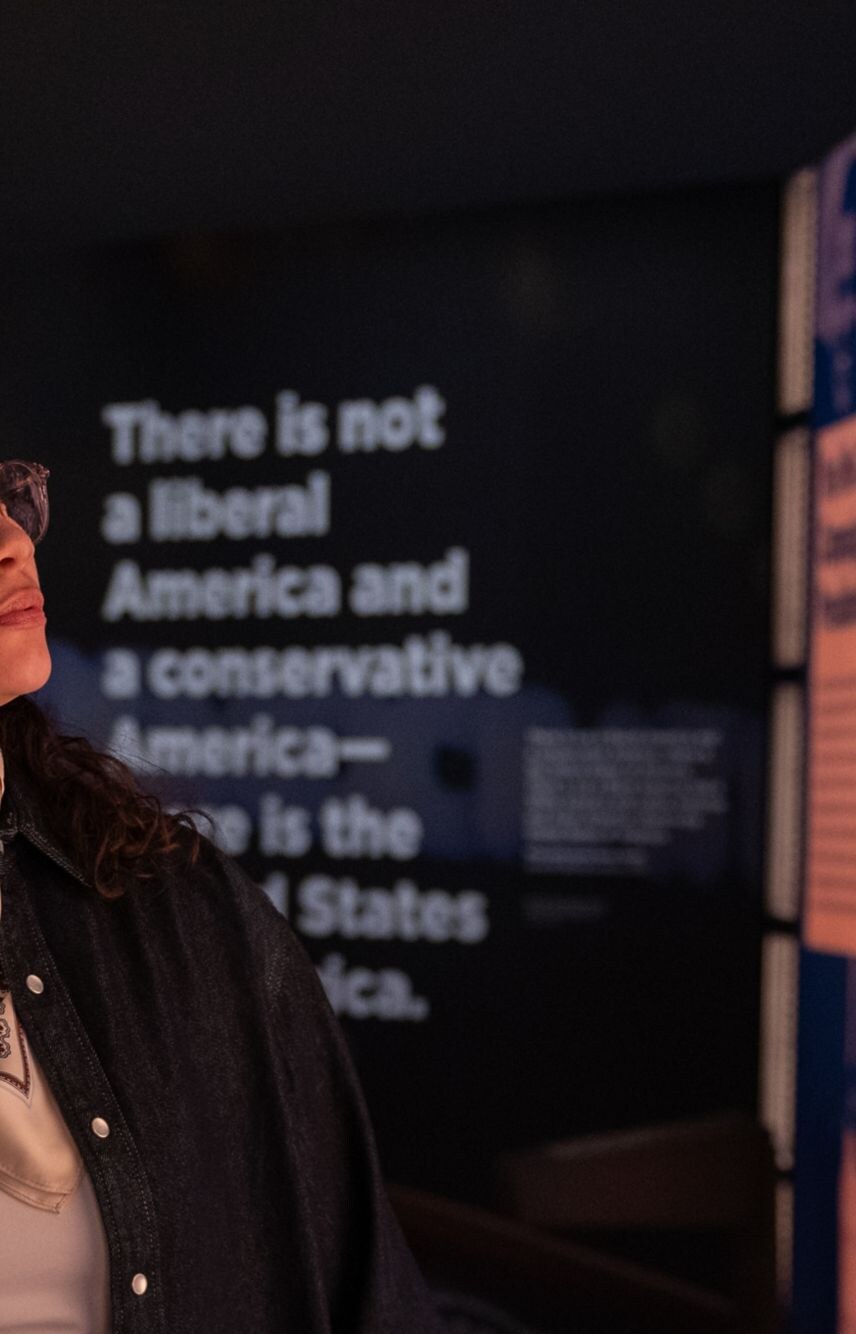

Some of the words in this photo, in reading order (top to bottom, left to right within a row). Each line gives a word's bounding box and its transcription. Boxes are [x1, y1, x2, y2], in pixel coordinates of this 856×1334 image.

[104, 403, 266, 463] There
[276, 391, 327, 454] is
[337, 386, 443, 451] not
[103, 493, 141, 542] a
[149, 471, 329, 539] liberal
[103, 556, 340, 620] America
[350, 547, 467, 614] and
[103, 650, 141, 698] a
[148, 632, 521, 698] conservative
[260, 795, 310, 856] is
[321, 795, 421, 858] the
[300, 876, 485, 940] States
[318, 954, 427, 1018] ica.
